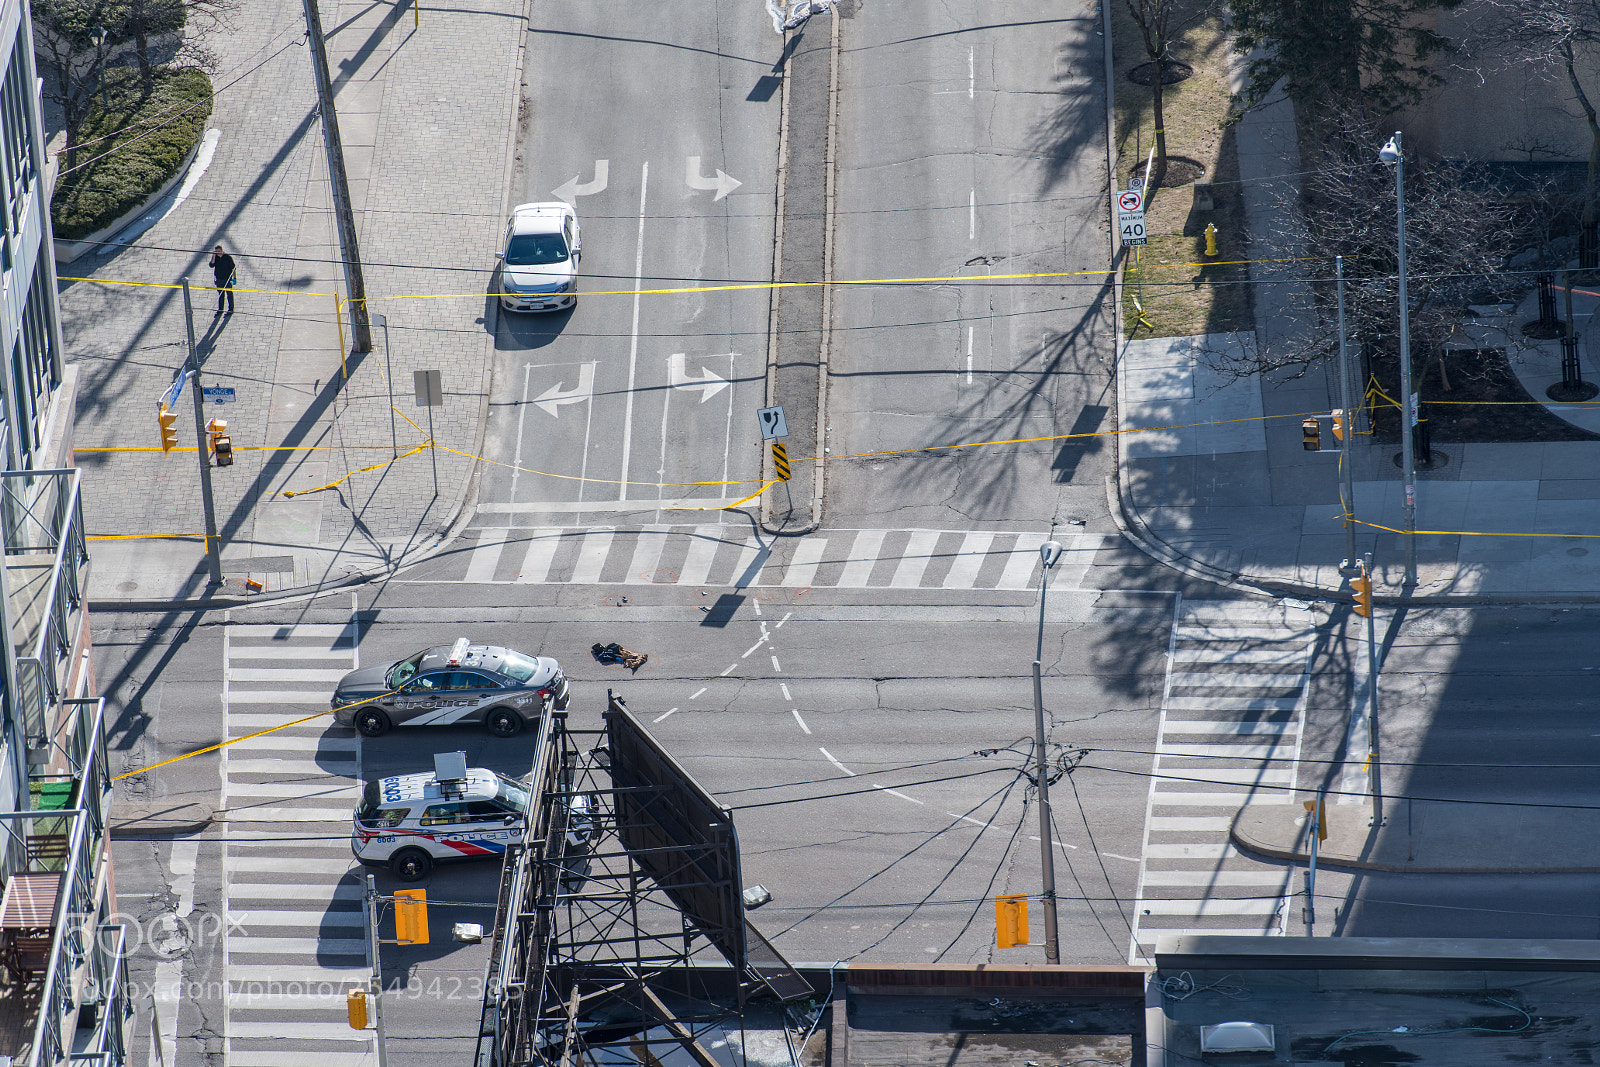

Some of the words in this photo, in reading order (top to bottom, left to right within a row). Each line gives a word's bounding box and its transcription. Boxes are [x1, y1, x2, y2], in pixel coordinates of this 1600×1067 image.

[1123, 224, 1143, 236] 40
[406, 699, 480, 710] POLICE
[384, 777, 402, 802] 6003
[377, 836, 396, 844] 6003
[433, 832, 509, 843] POLICE
